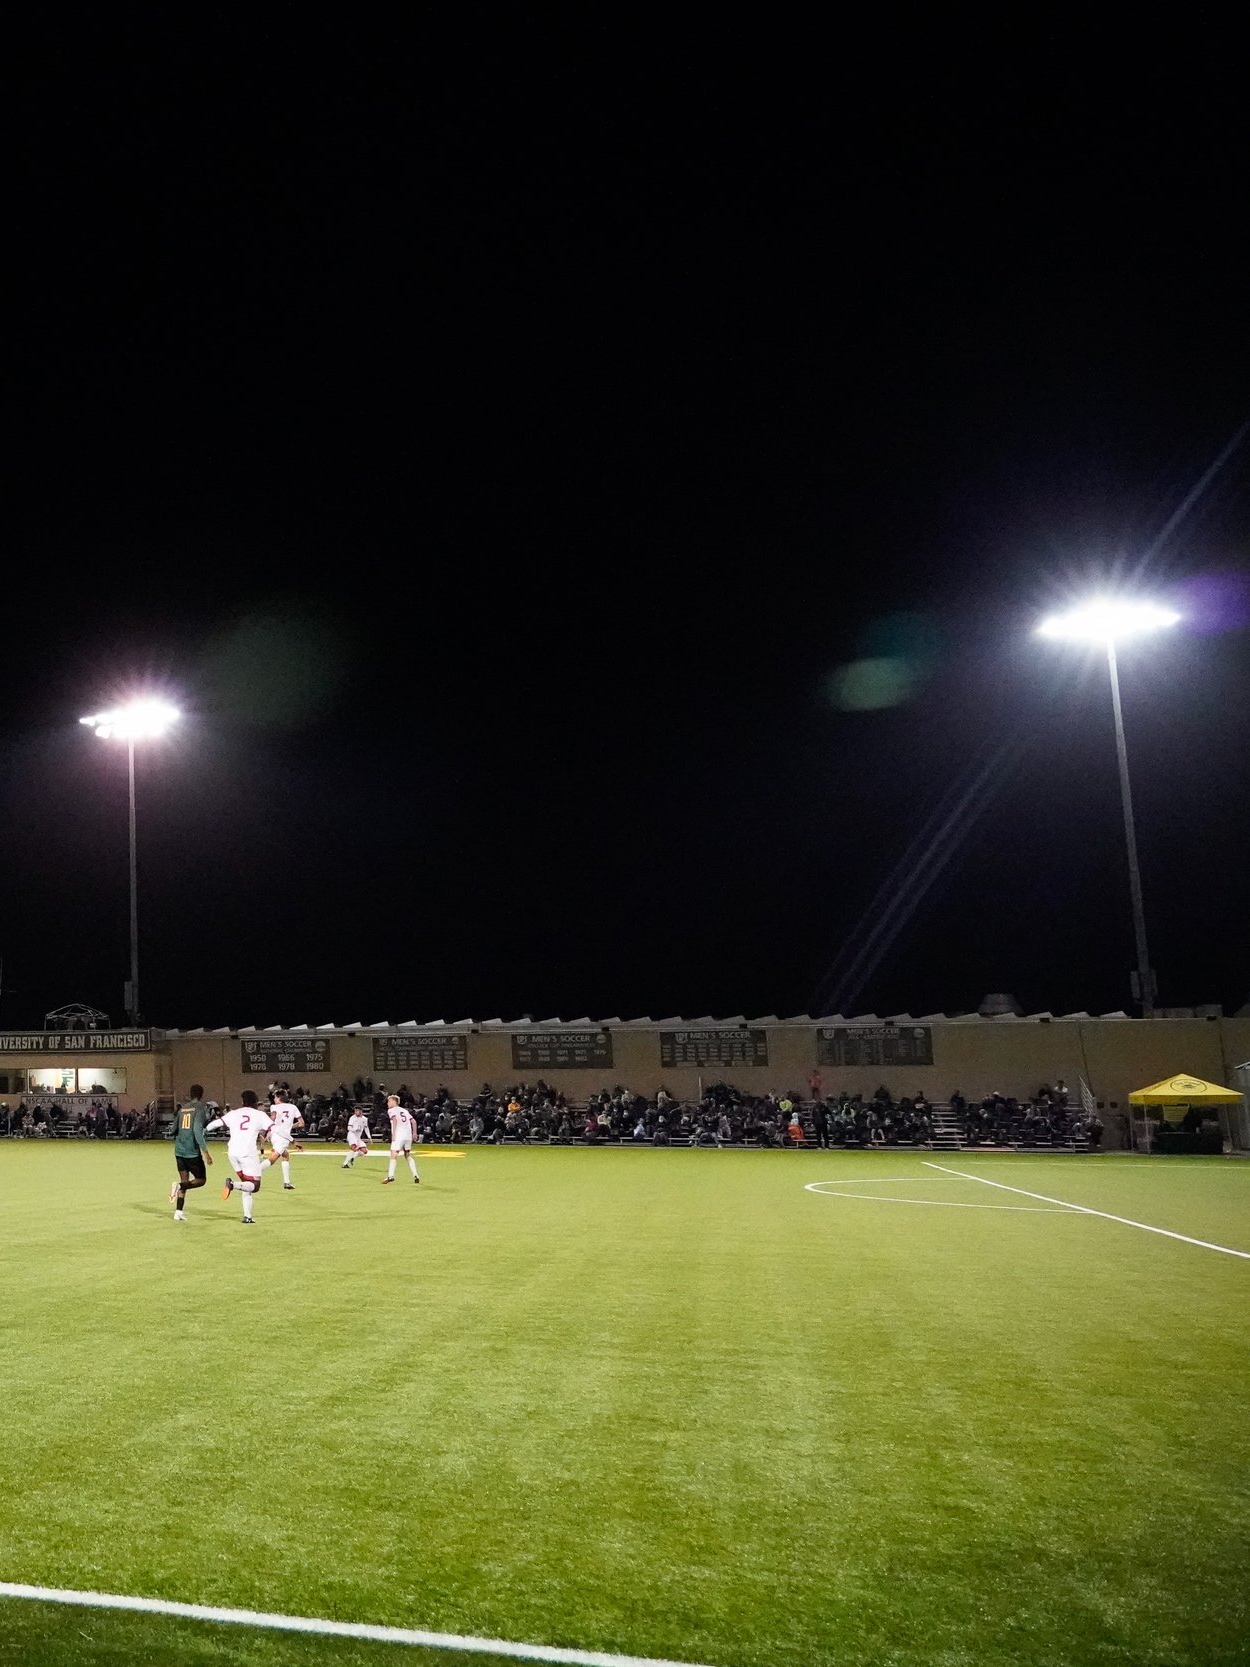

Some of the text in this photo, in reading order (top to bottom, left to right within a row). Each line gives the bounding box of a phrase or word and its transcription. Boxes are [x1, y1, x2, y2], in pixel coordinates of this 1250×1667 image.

[49, 1036, 60, 1049] OF
[64, 1035, 85, 1049] SAN
[90, 1033, 145, 1048] FRANCISCO
[285, 1040, 312, 1048] SOCCER
[250, 1054, 267, 1062] 1950
[306, 1053, 323, 1061] 1975
[278, 1062, 295, 1070] 1978
[306, 1062, 324, 1070] 1980
[282, 1110, 289, 1119] 3
[399, 1111, 407, 1123] 5
[182, 1113, 191, 1129] 10
[240, 1115, 250, 1130] 2
